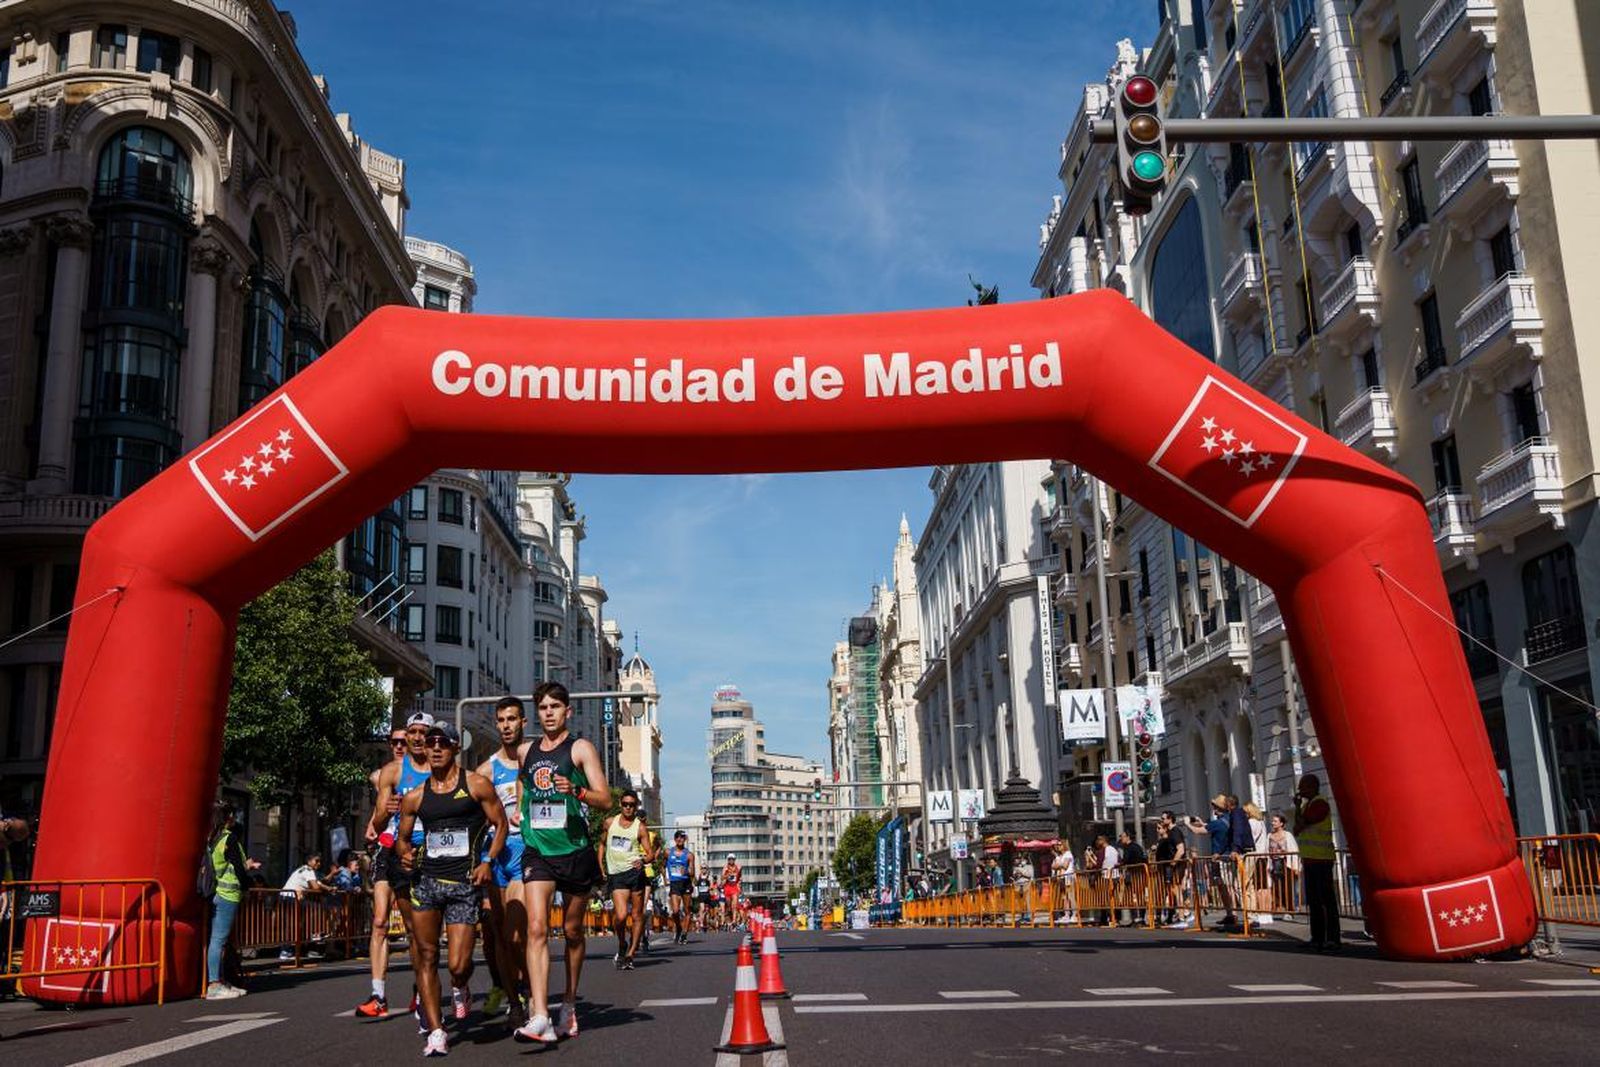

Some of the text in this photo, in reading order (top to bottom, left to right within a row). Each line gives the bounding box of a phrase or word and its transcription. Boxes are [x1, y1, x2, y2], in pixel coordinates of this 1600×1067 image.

[431, 341, 1063, 403] Comunidad de Madrid
[540, 806, 552, 817] 41
[440, 833, 455, 846] 30
[28, 893, 51, 905] AHS
